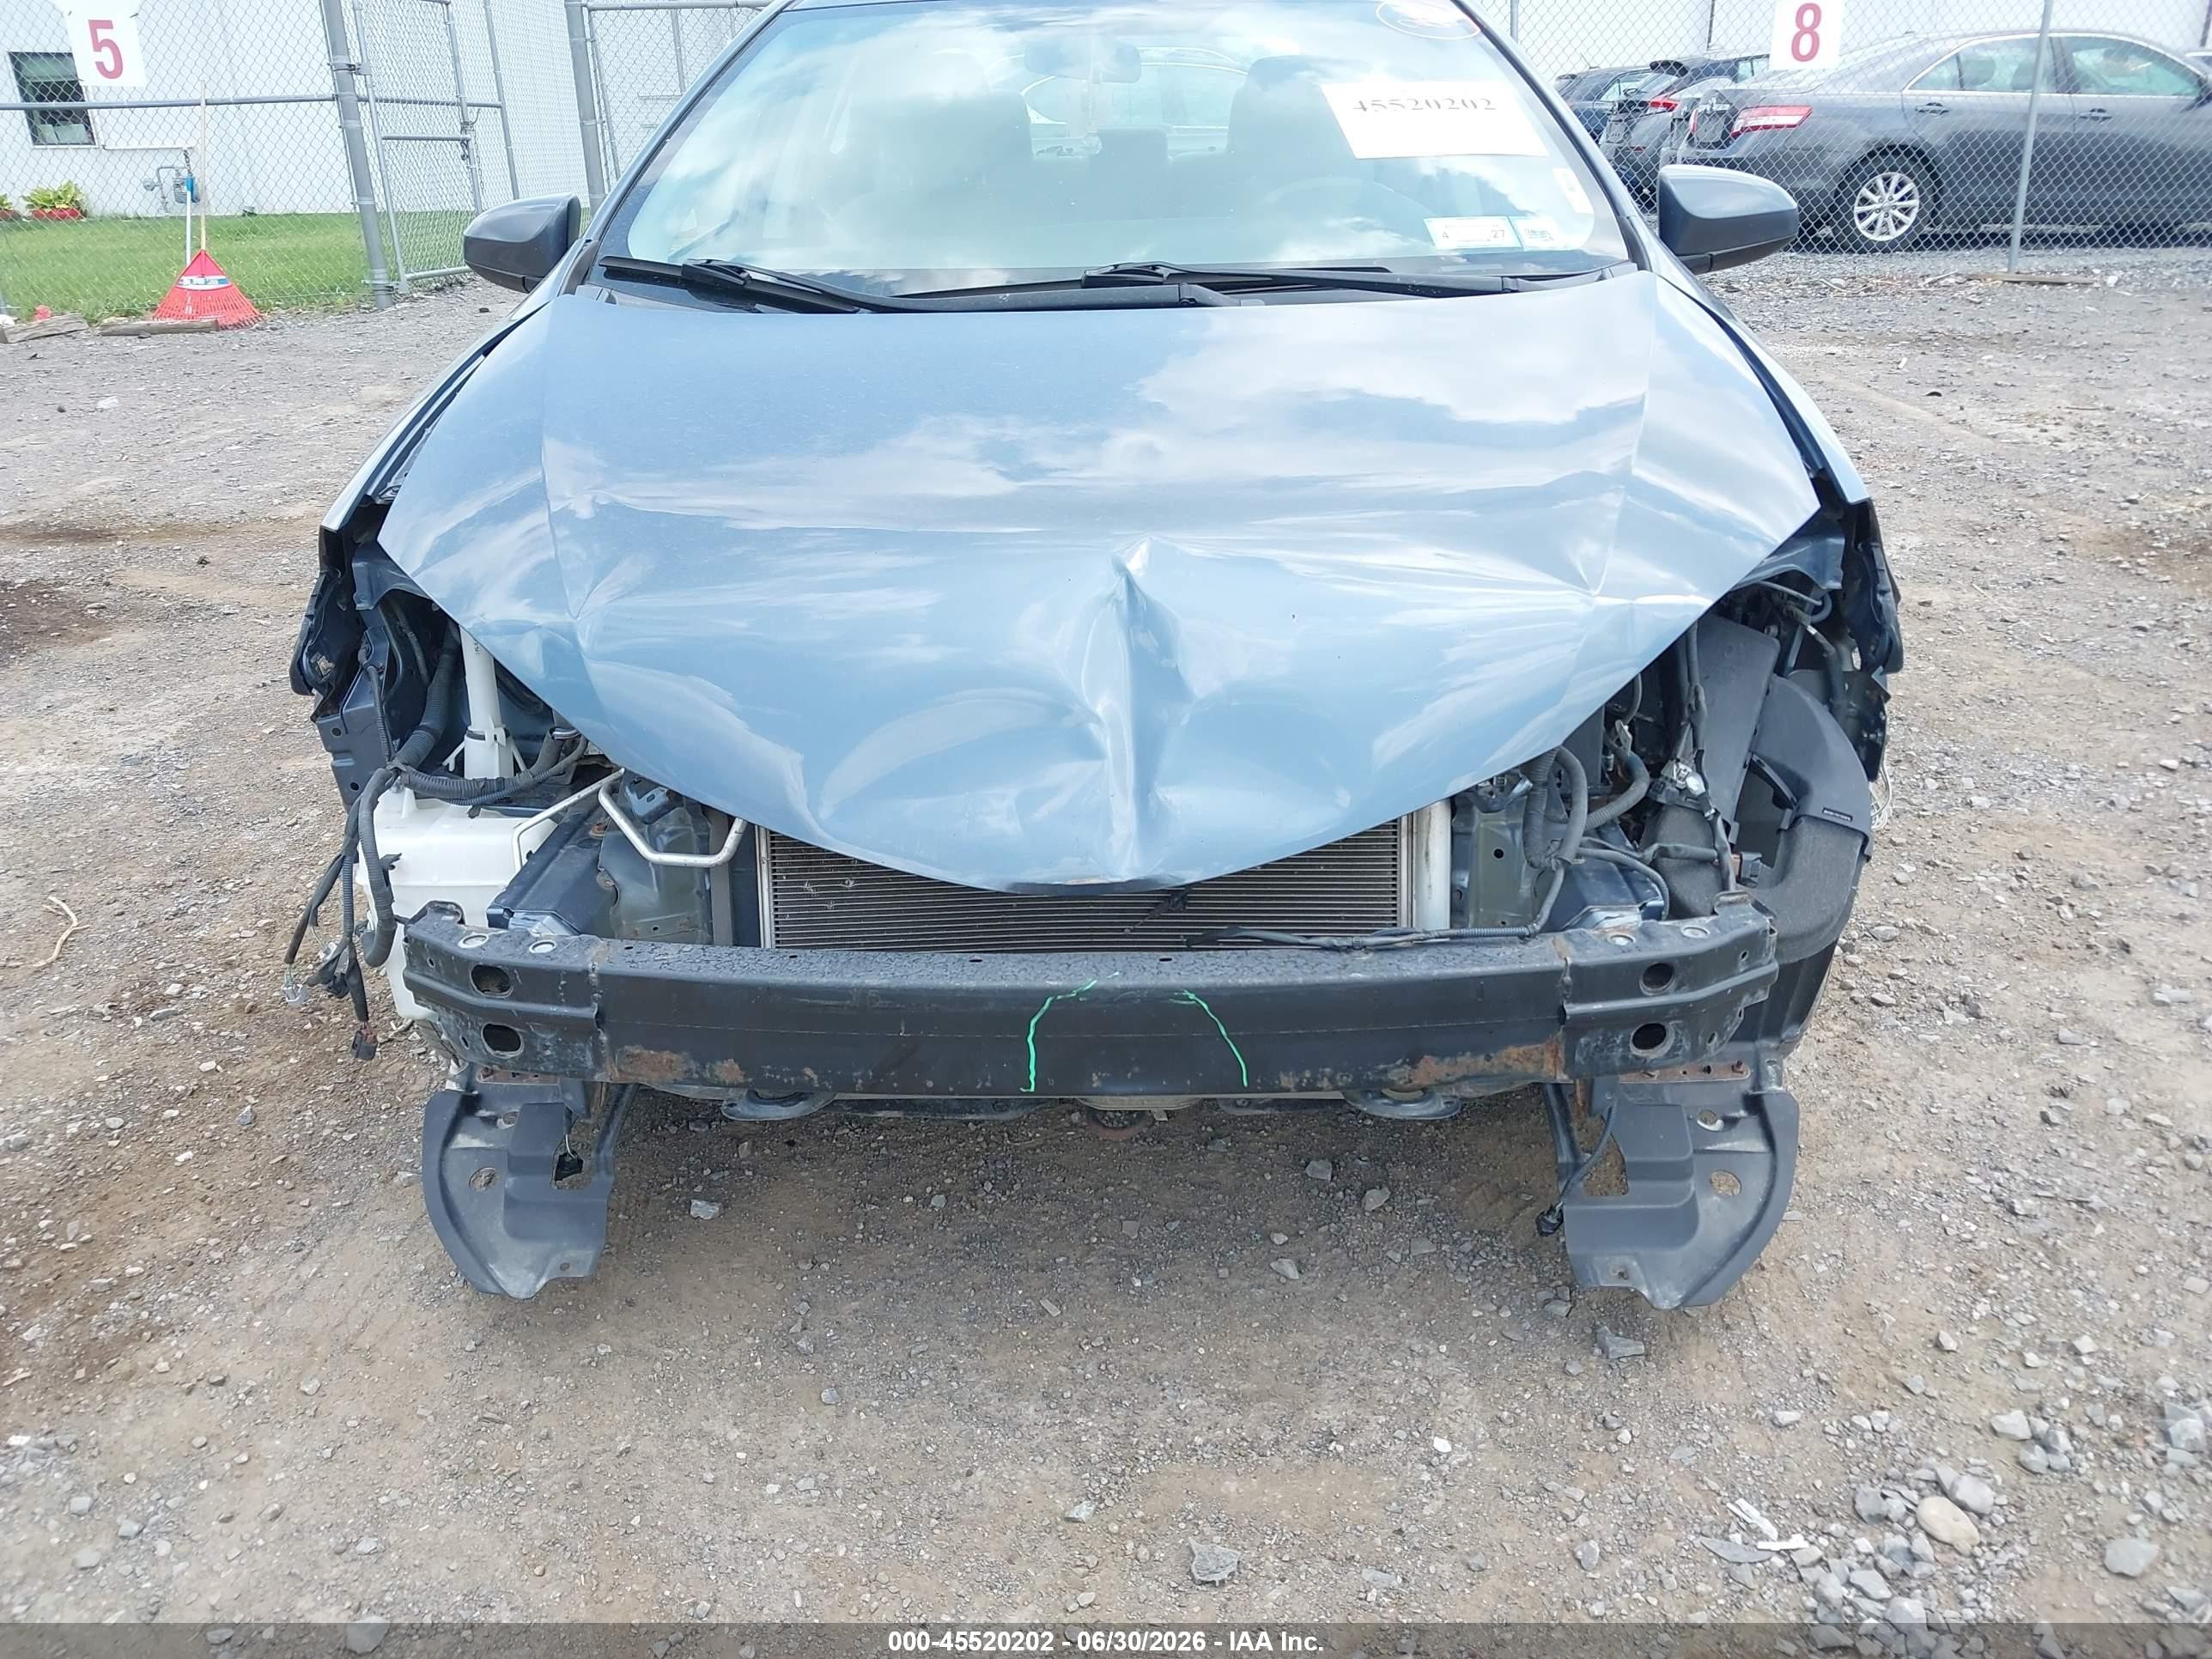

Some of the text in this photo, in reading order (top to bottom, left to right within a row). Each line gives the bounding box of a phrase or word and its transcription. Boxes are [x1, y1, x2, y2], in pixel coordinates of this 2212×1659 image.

[88, 19, 124, 80] 5
[1791, 3, 1821, 62] 8
[1352, 96, 1498, 112] 45520202
